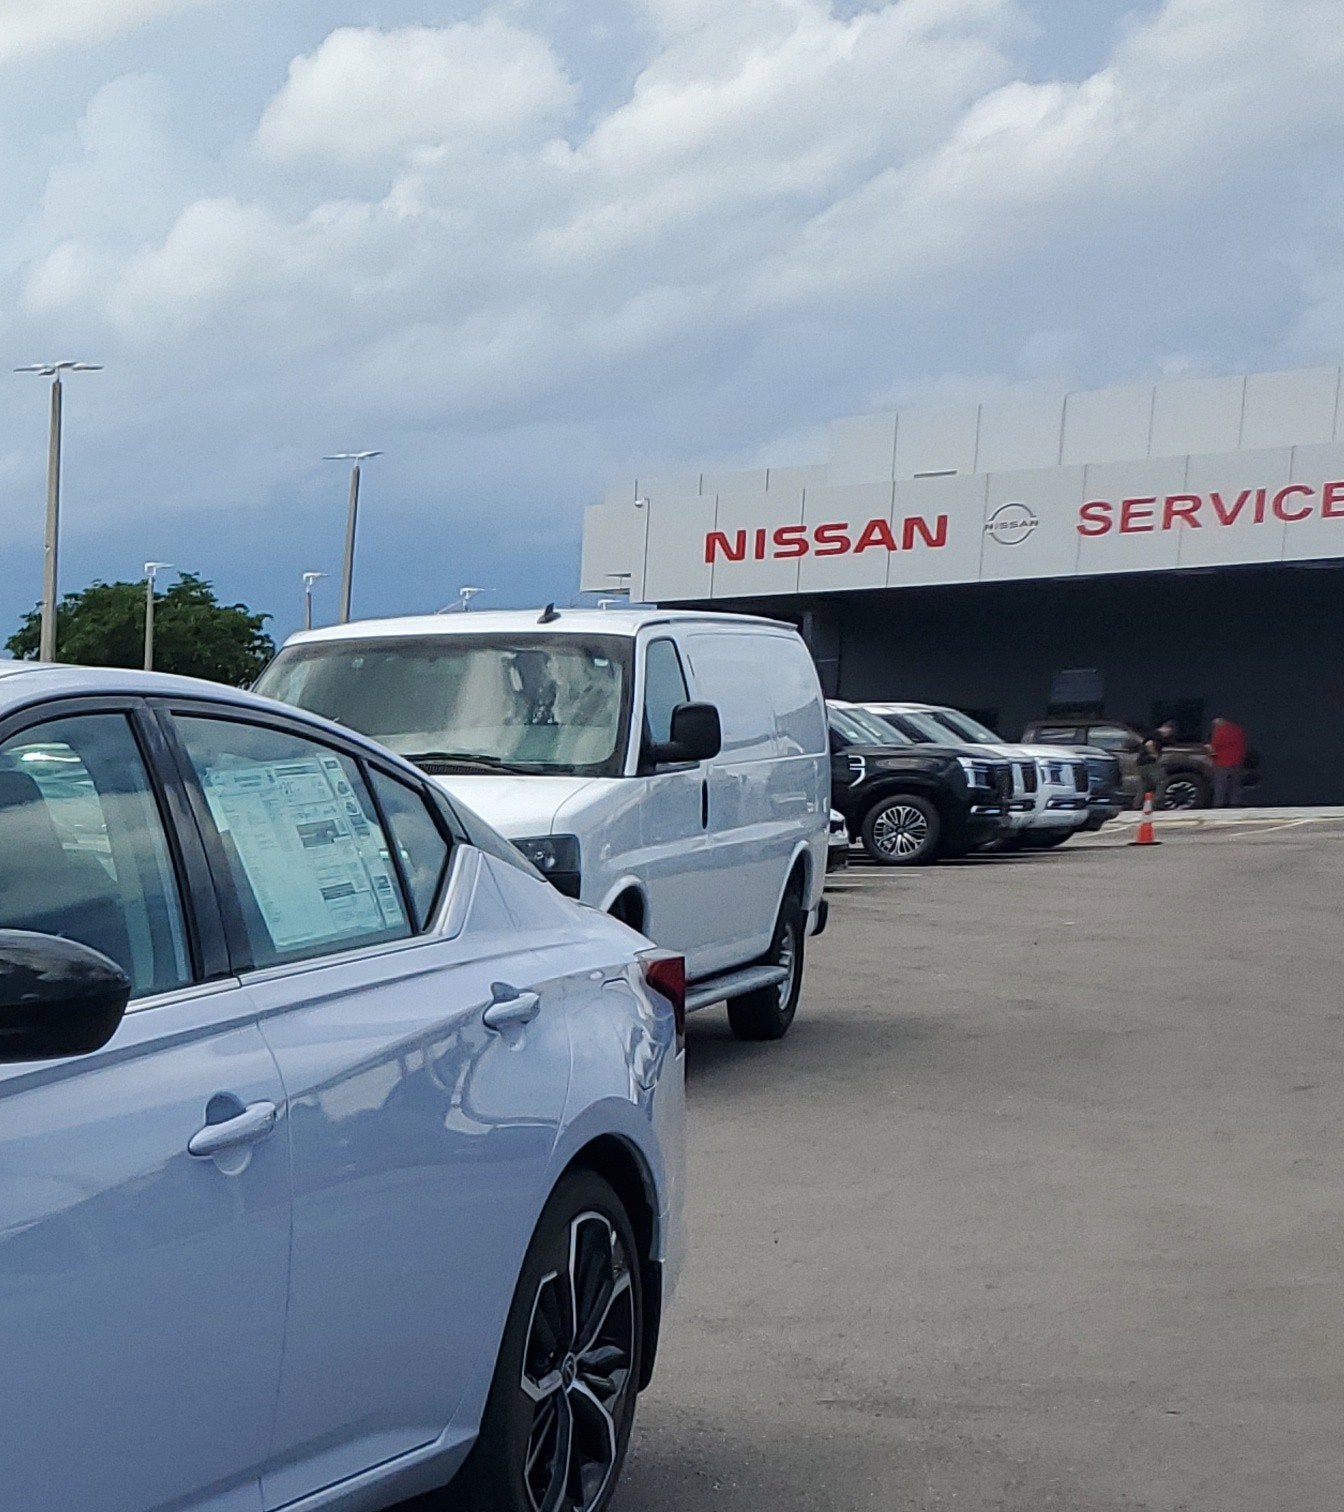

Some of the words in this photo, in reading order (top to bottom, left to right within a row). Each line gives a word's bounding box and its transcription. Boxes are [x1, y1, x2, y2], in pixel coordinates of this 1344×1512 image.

[984, 518, 1039, 531] NISSAN
[1076, 481, 1344, 536] SERVICE
[704, 514, 949, 563] NISSAN
